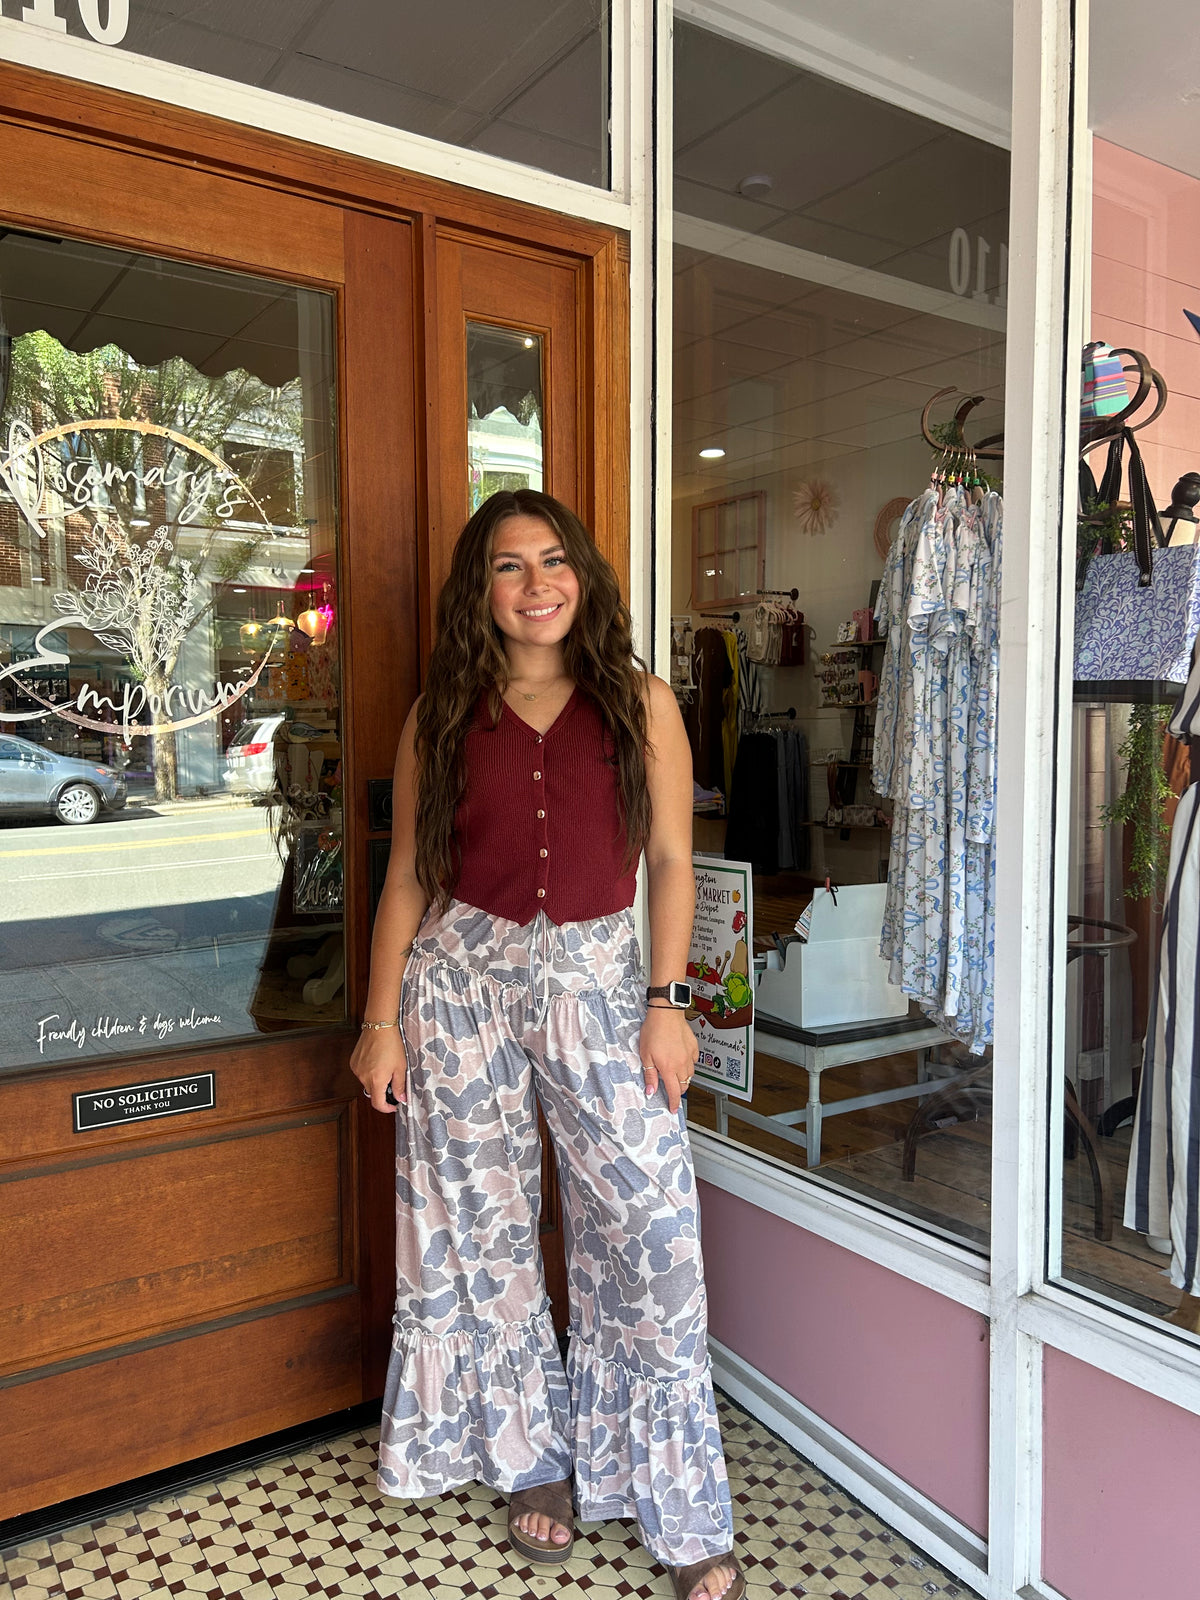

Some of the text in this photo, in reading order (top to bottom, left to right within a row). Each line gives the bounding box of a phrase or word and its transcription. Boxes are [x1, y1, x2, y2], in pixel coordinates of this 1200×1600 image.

[0, 616, 258, 746] Emporium
[703, 887, 730, 904] MARKET
[139, 1015, 147, 1034] &
[153, 1013, 175, 1039] dogs
[707, 1033, 740, 1052] Homemade
[93, 1083, 198, 1111] NO SOLICITING
[124, 1101, 170, 1115] THANK YOU
